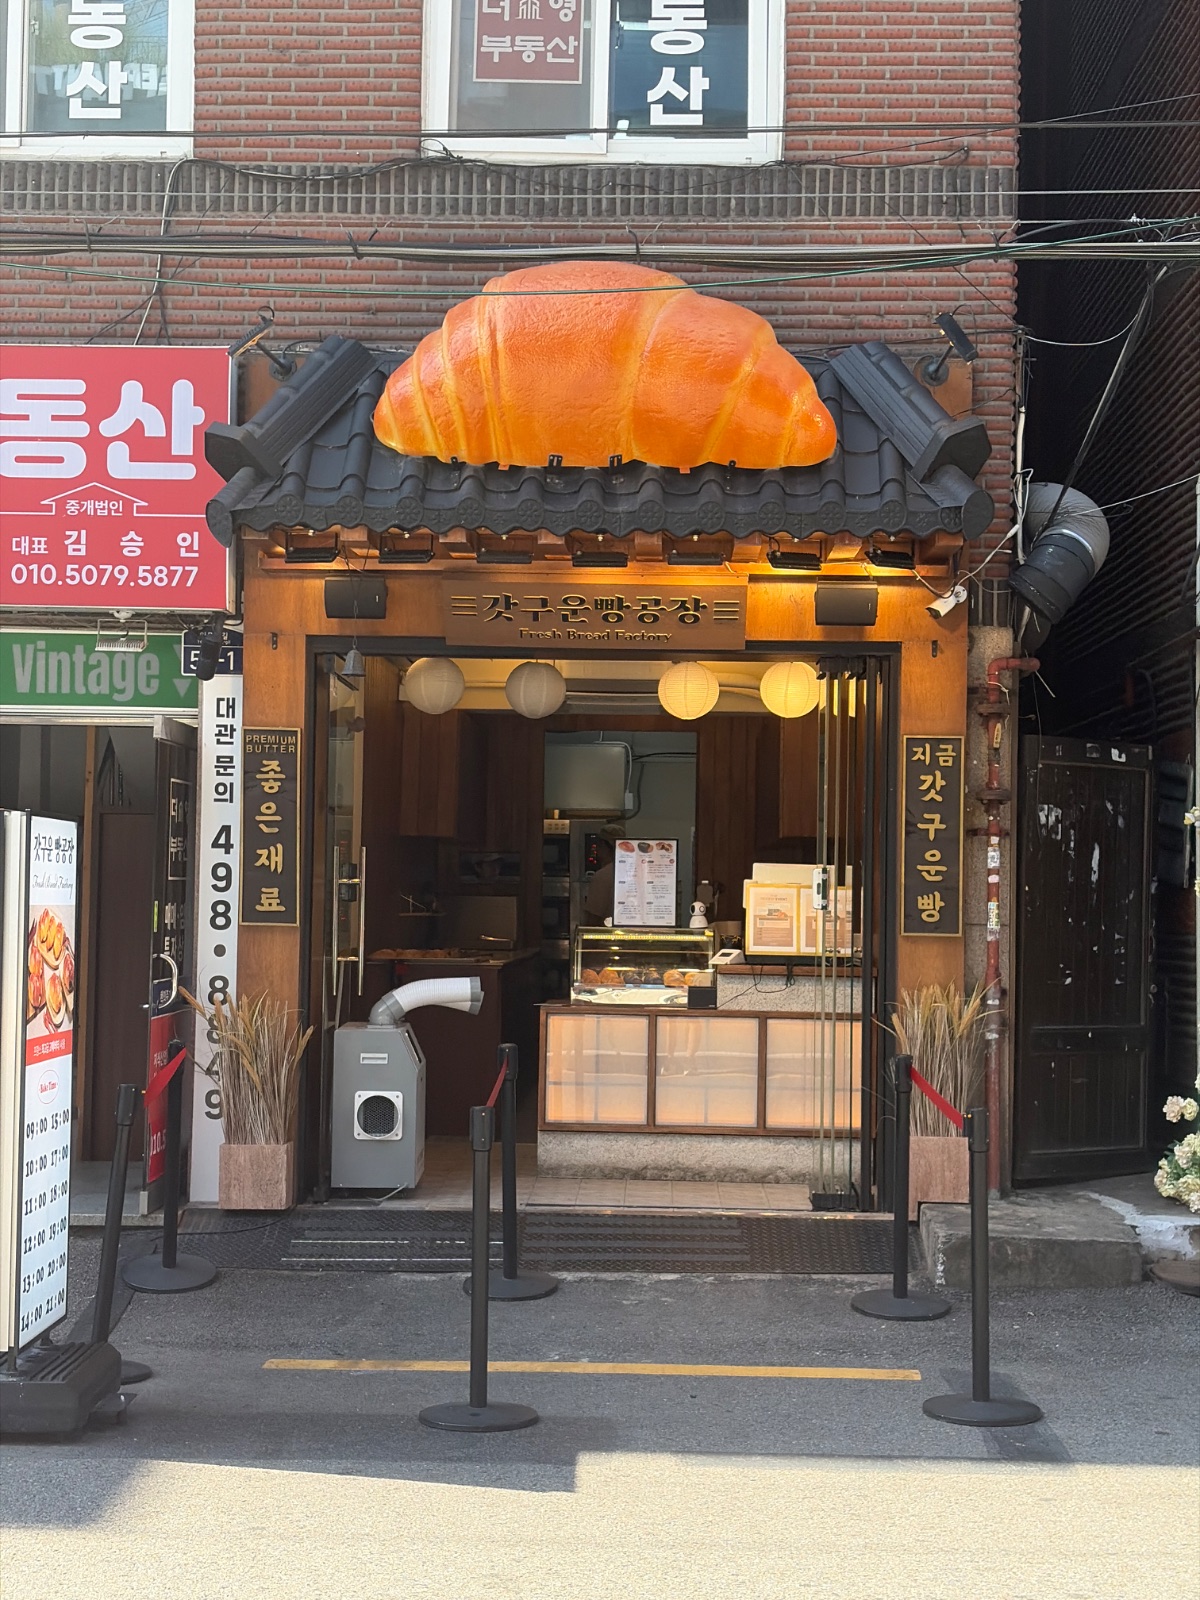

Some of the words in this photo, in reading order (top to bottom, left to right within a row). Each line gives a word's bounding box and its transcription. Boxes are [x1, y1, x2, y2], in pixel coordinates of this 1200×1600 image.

[480, 35, 579, 63] 부동산
[0, 378, 206, 480] 동산
[65, 499, 124, 517] 중개법인
[11, 536, 49, 556] 대표
[63, 529, 87, 556] 김
[119, 531, 145, 557] 승
[176, 532, 200, 558] 인
[10, 563, 199, 588] 010.5079.5877
[518, 627, 562, 640] Fresh
[567, 628, 610, 641] Bread
[614, 628, 672, 643] Factory
[12, 640, 161, 702] Vintage
[245, 734, 297, 745] PREMIUM
[246, 744, 296, 754] BUTTER
[911, 743, 957, 767] 지금
[26, 1117, 48, 1140] 09:00
[51, 1108, 70, 1131] 15:00
[25, 1154, 48, 1178] 10:00
[51, 1144, 69, 1168] 17:00
[24, 1191, 47, 1216] 11:00
[50, 1180, 68, 1203] 18:00
[23, 1229, 46, 1255] 12:00
[48, 1216, 67, 1241] 19:00
[22, 1266, 45, 1294] 13:00
[47, 1252, 66, 1278] 20:00
[21, 1304, 43, 1332] 14:00
[45, 1288, 65, 1315] 21:00
